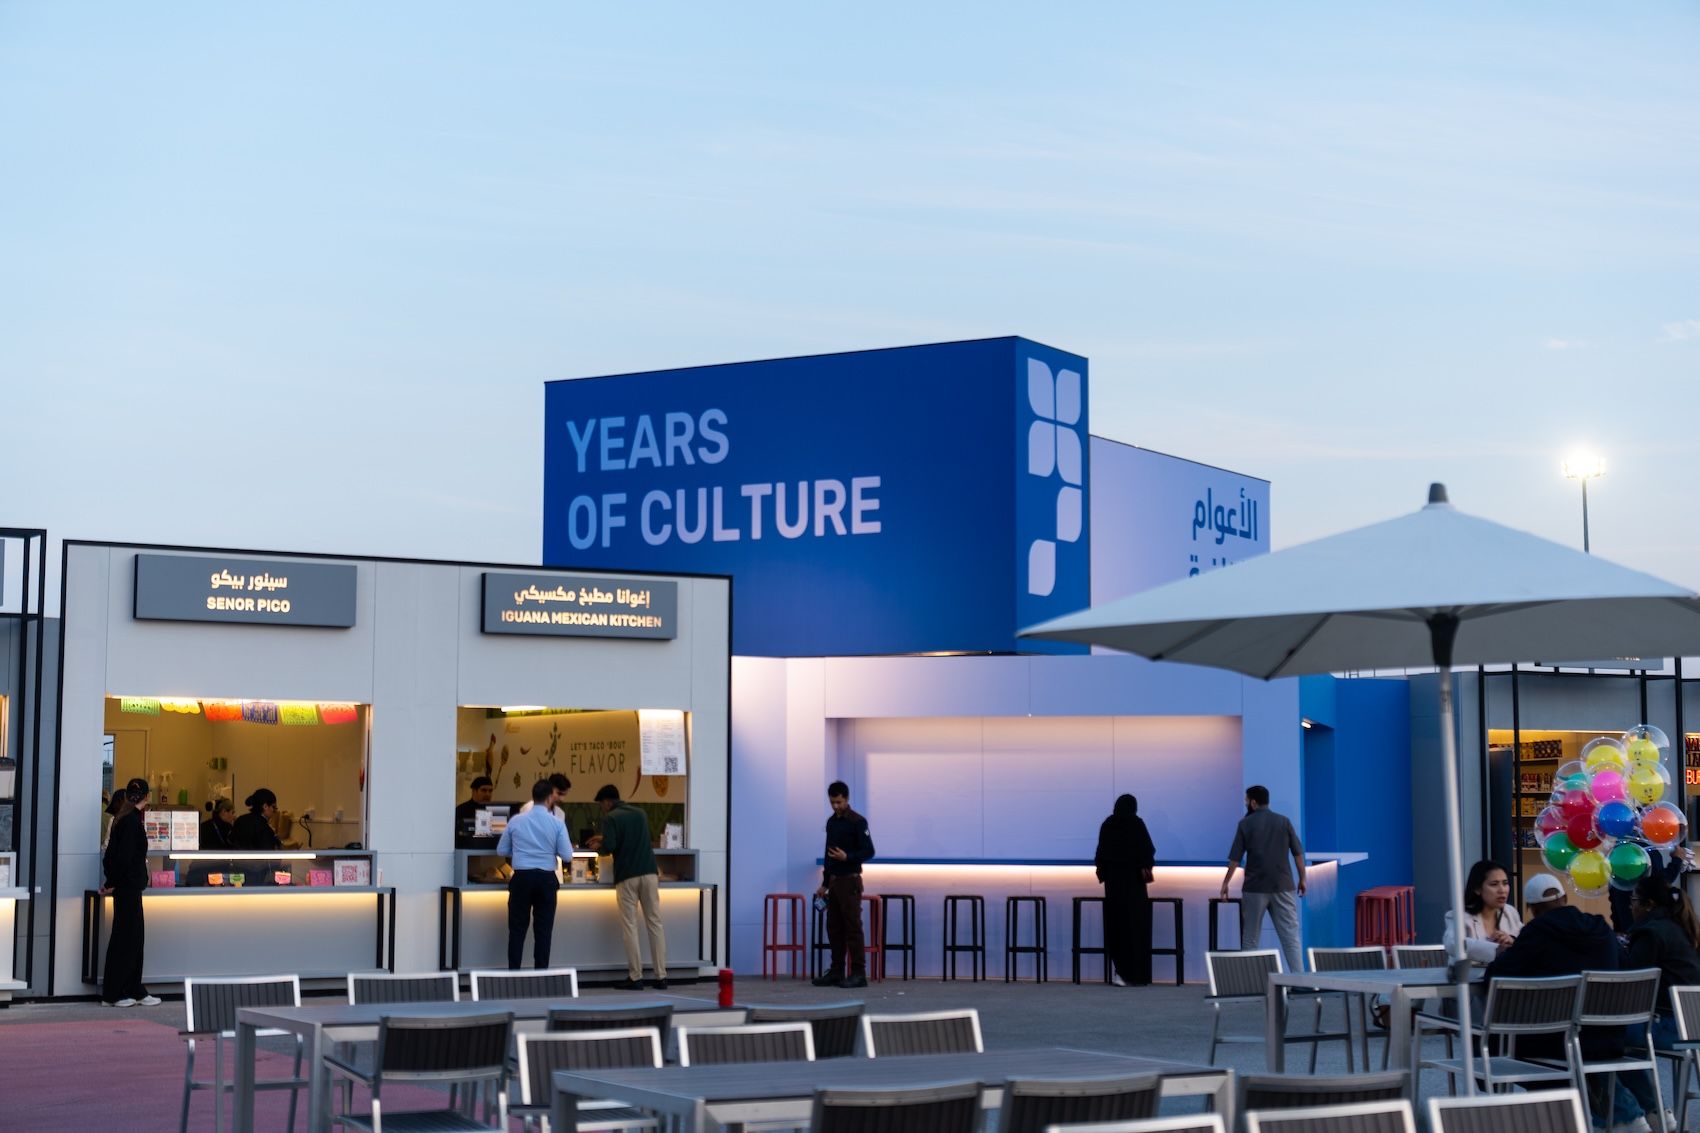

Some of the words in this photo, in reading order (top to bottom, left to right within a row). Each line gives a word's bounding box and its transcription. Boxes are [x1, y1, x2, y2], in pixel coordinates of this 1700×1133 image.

[566, 408, 729, 473] YEARS
[568, 493, 627, 550] OF
[641, 476, 882, 546] CULTURE
[1193, 487, 1258, 546] الأعوام
[210, 568, 245, 590] بيكو
[247, 572, 288, 592] سينور
[206, 596, 255, 611] SENOR
[257, 598, 291, 613] PICO
[514, 585, 576, 605] مكسيكي
[578, 586, 614, 606] مطبخ
[616, 588, 651, 609] إغوانا
[501, 610, 551, 624] IGUANA
[551, 611, 608, 627] MEXICAN
[609, 614, 663, 628] KITCHEN
[589, 741, 605, 750] TACO
[570, 752, 626, 775] FLAVOR
